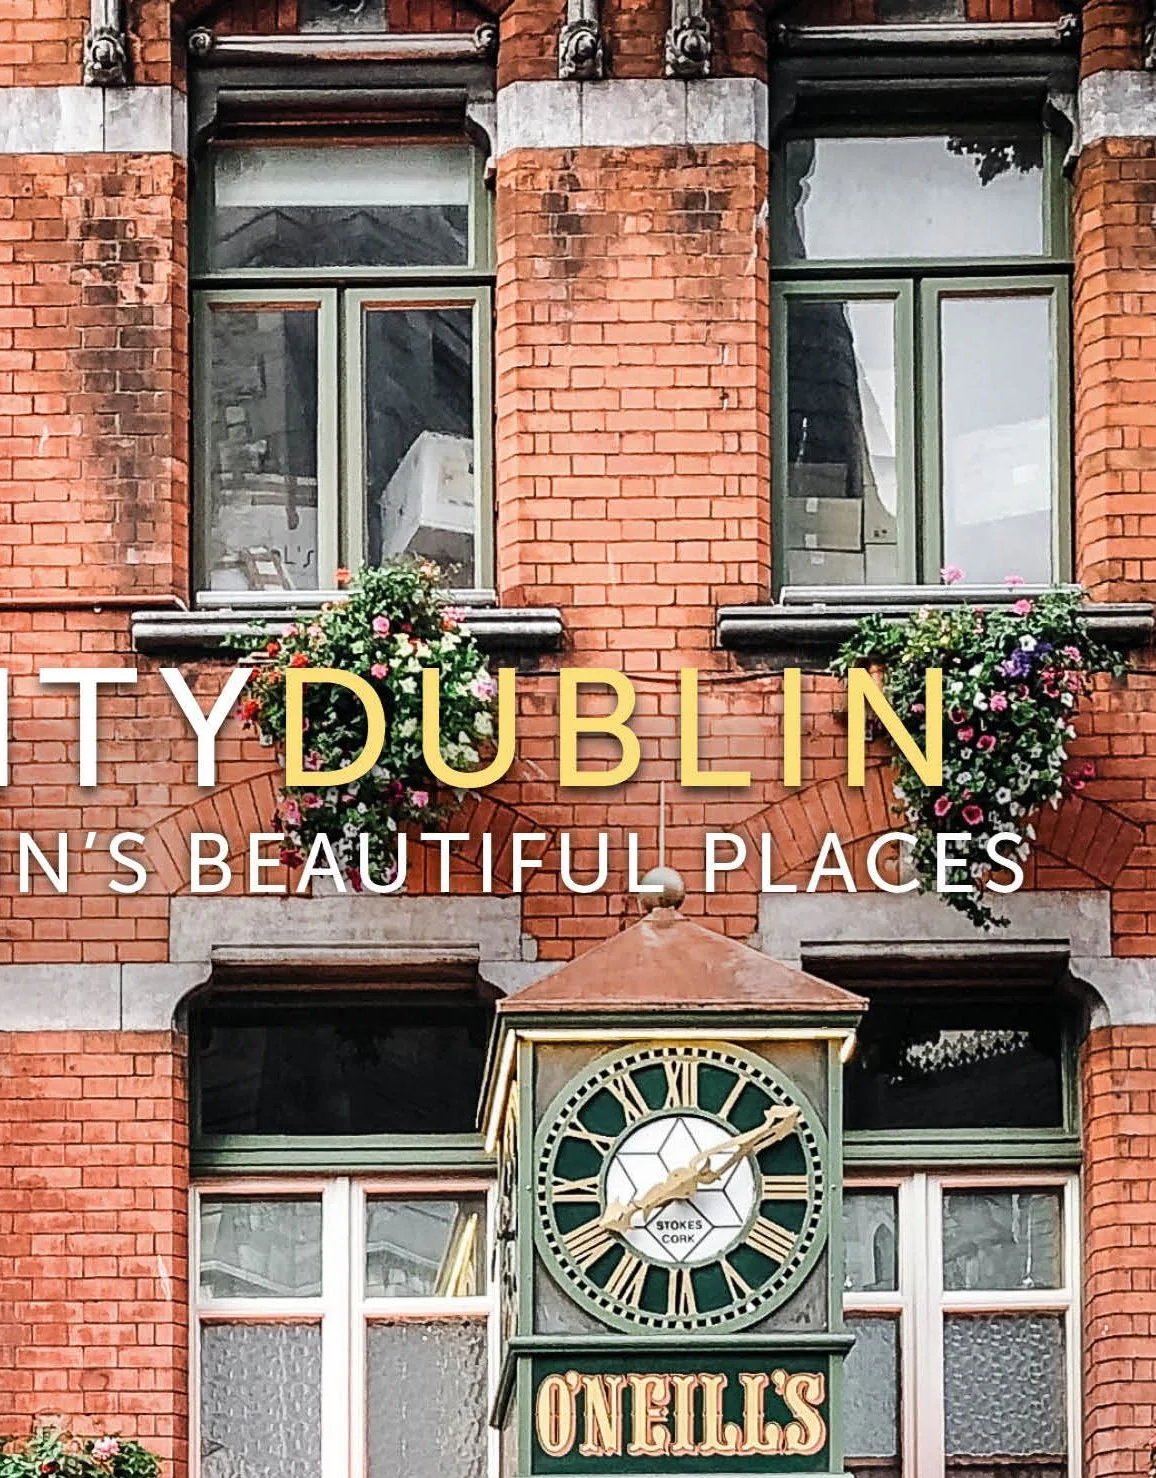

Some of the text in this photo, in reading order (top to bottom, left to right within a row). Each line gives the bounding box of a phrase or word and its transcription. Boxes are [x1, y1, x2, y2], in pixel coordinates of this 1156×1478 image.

[655, 1220, 703, 1231] STOKES
[661, 1233, 695, 1244] CORK
[535, 1368, 827, 1457] O'NEILL'S
